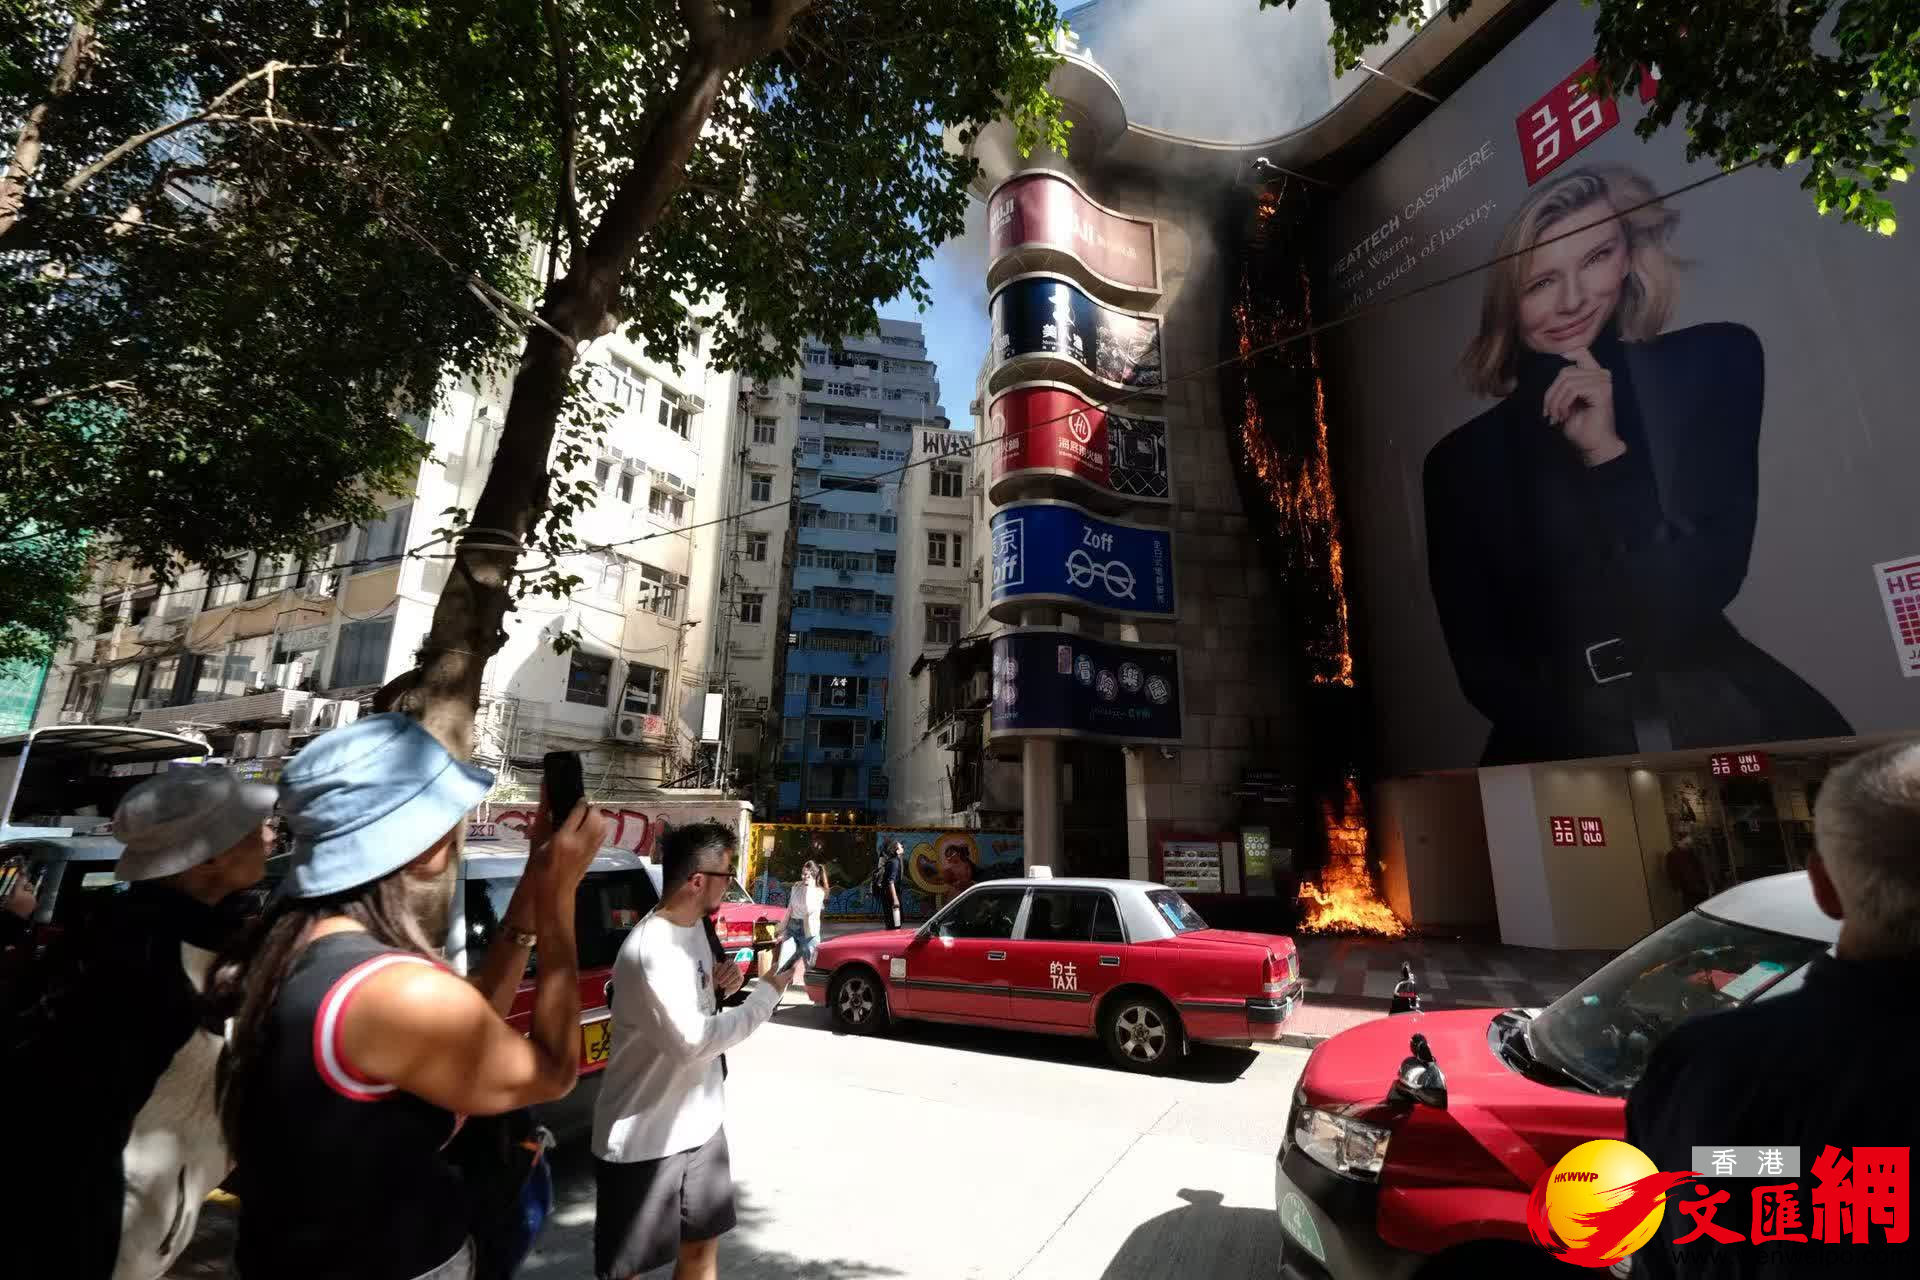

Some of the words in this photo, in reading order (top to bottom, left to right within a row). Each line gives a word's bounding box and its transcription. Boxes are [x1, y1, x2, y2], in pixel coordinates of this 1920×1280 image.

[1333, 215, 1400, 273] EATTECH
[1404, 139, 1495, 220] CASHMERE
[1082, 525, 1113, 553] Zoff
[993, 554, 1018, 585] off
[1738, 754, 1758, 764] UNI
[1740, 763, 1760, 774] QLO
[1581, 820, 1598, 831] UNI
[1584, 832, 1602, 844] QLO
[1050, 960, 1077, 976] 的士
[1050, 974, 1077, 991] TAXI
